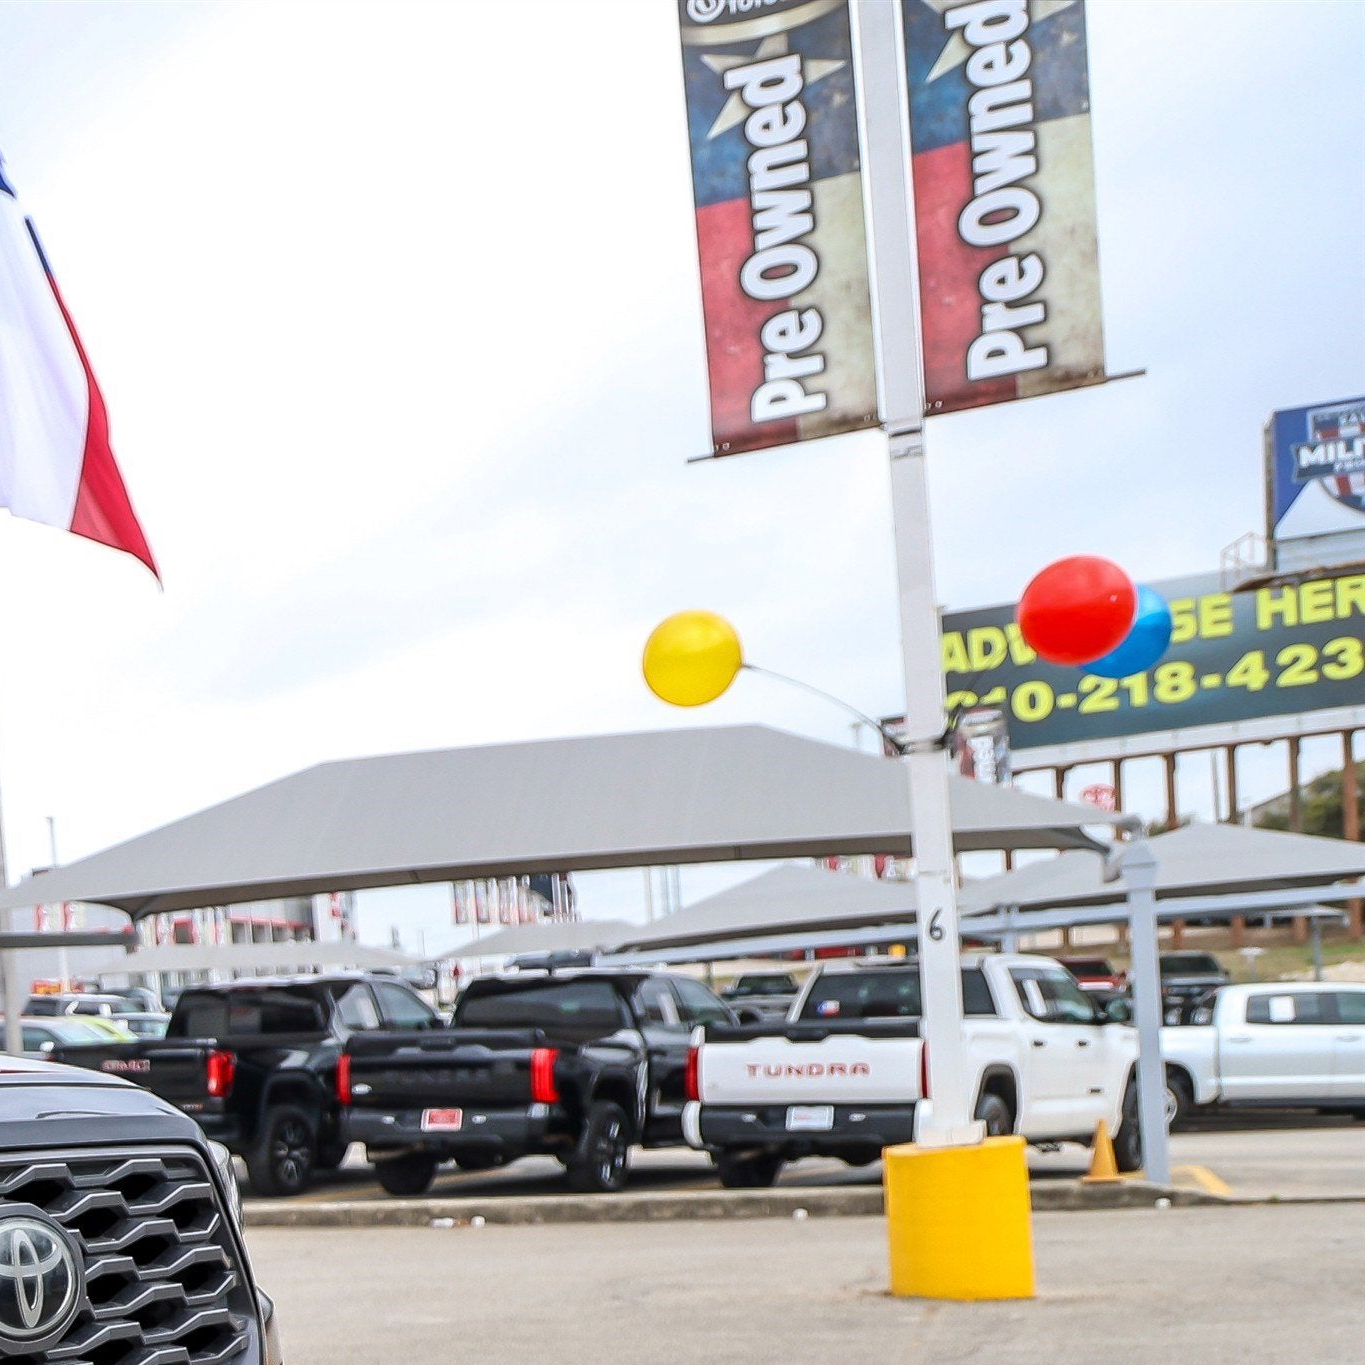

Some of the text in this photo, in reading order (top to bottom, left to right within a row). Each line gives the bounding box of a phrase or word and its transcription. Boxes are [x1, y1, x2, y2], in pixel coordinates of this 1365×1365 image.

[723, 53, 819, 301] Owned
[944, 0, 1048, 382] Pre Owned
[750, 306, 826, 423] Pre
[928, 908, 946, 940] 6
[746, 1062, 871, 1079] TUNDRA
